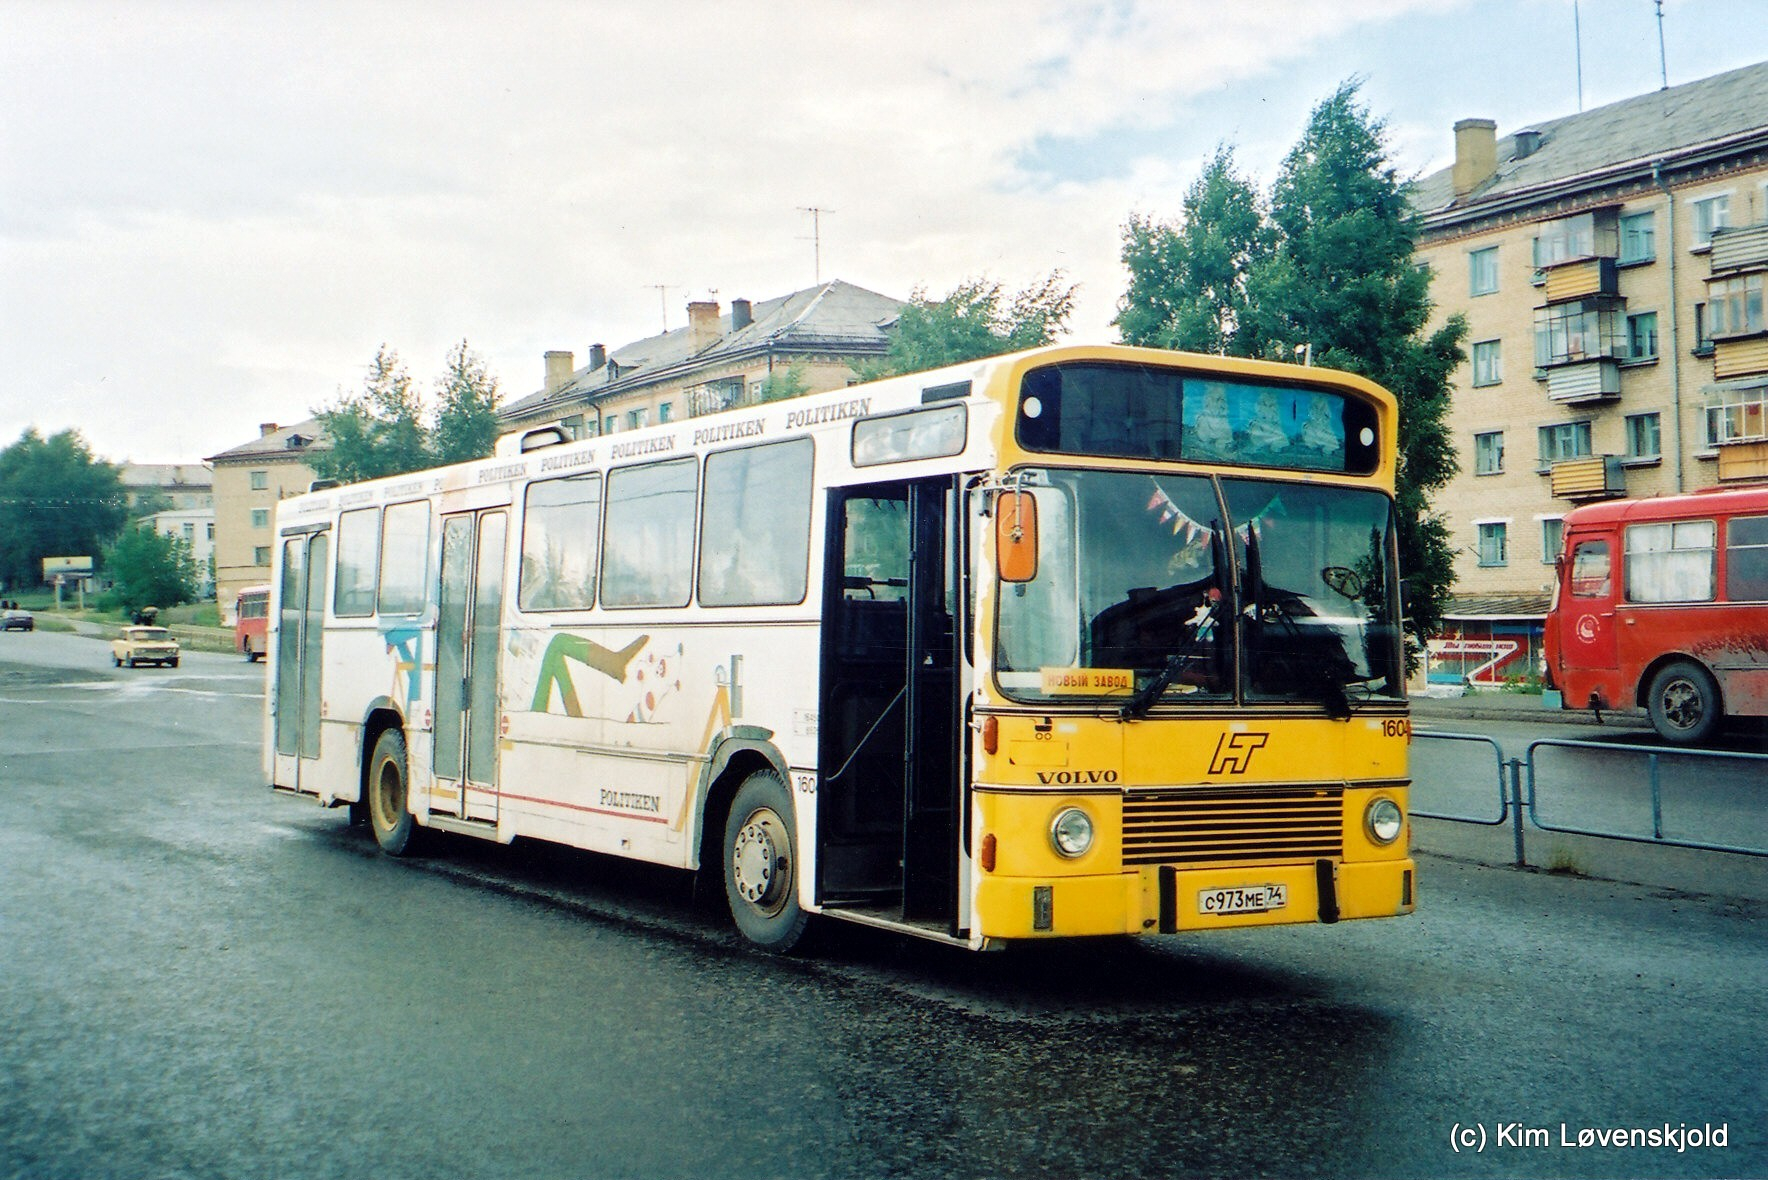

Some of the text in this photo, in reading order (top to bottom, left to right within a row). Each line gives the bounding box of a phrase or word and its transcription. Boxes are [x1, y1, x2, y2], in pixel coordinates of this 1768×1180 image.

[541, 449, 597, 473] POLITIKEN
[611, 434, 677, 459] POLITIKEN
[693, 418, 767, 446] POLITIKEN
[785, 398, 873, 429] POLITIKEN
[1047, 672, 1128, 689] НОВЫЙ ЗАВОД
[798, 776, 818, 794] 160
[1036, 770, 1118, 785] VOLVO
[600, 788, 661, 812] POLITIKEN
[1266, 886, 1282, 901] 74
